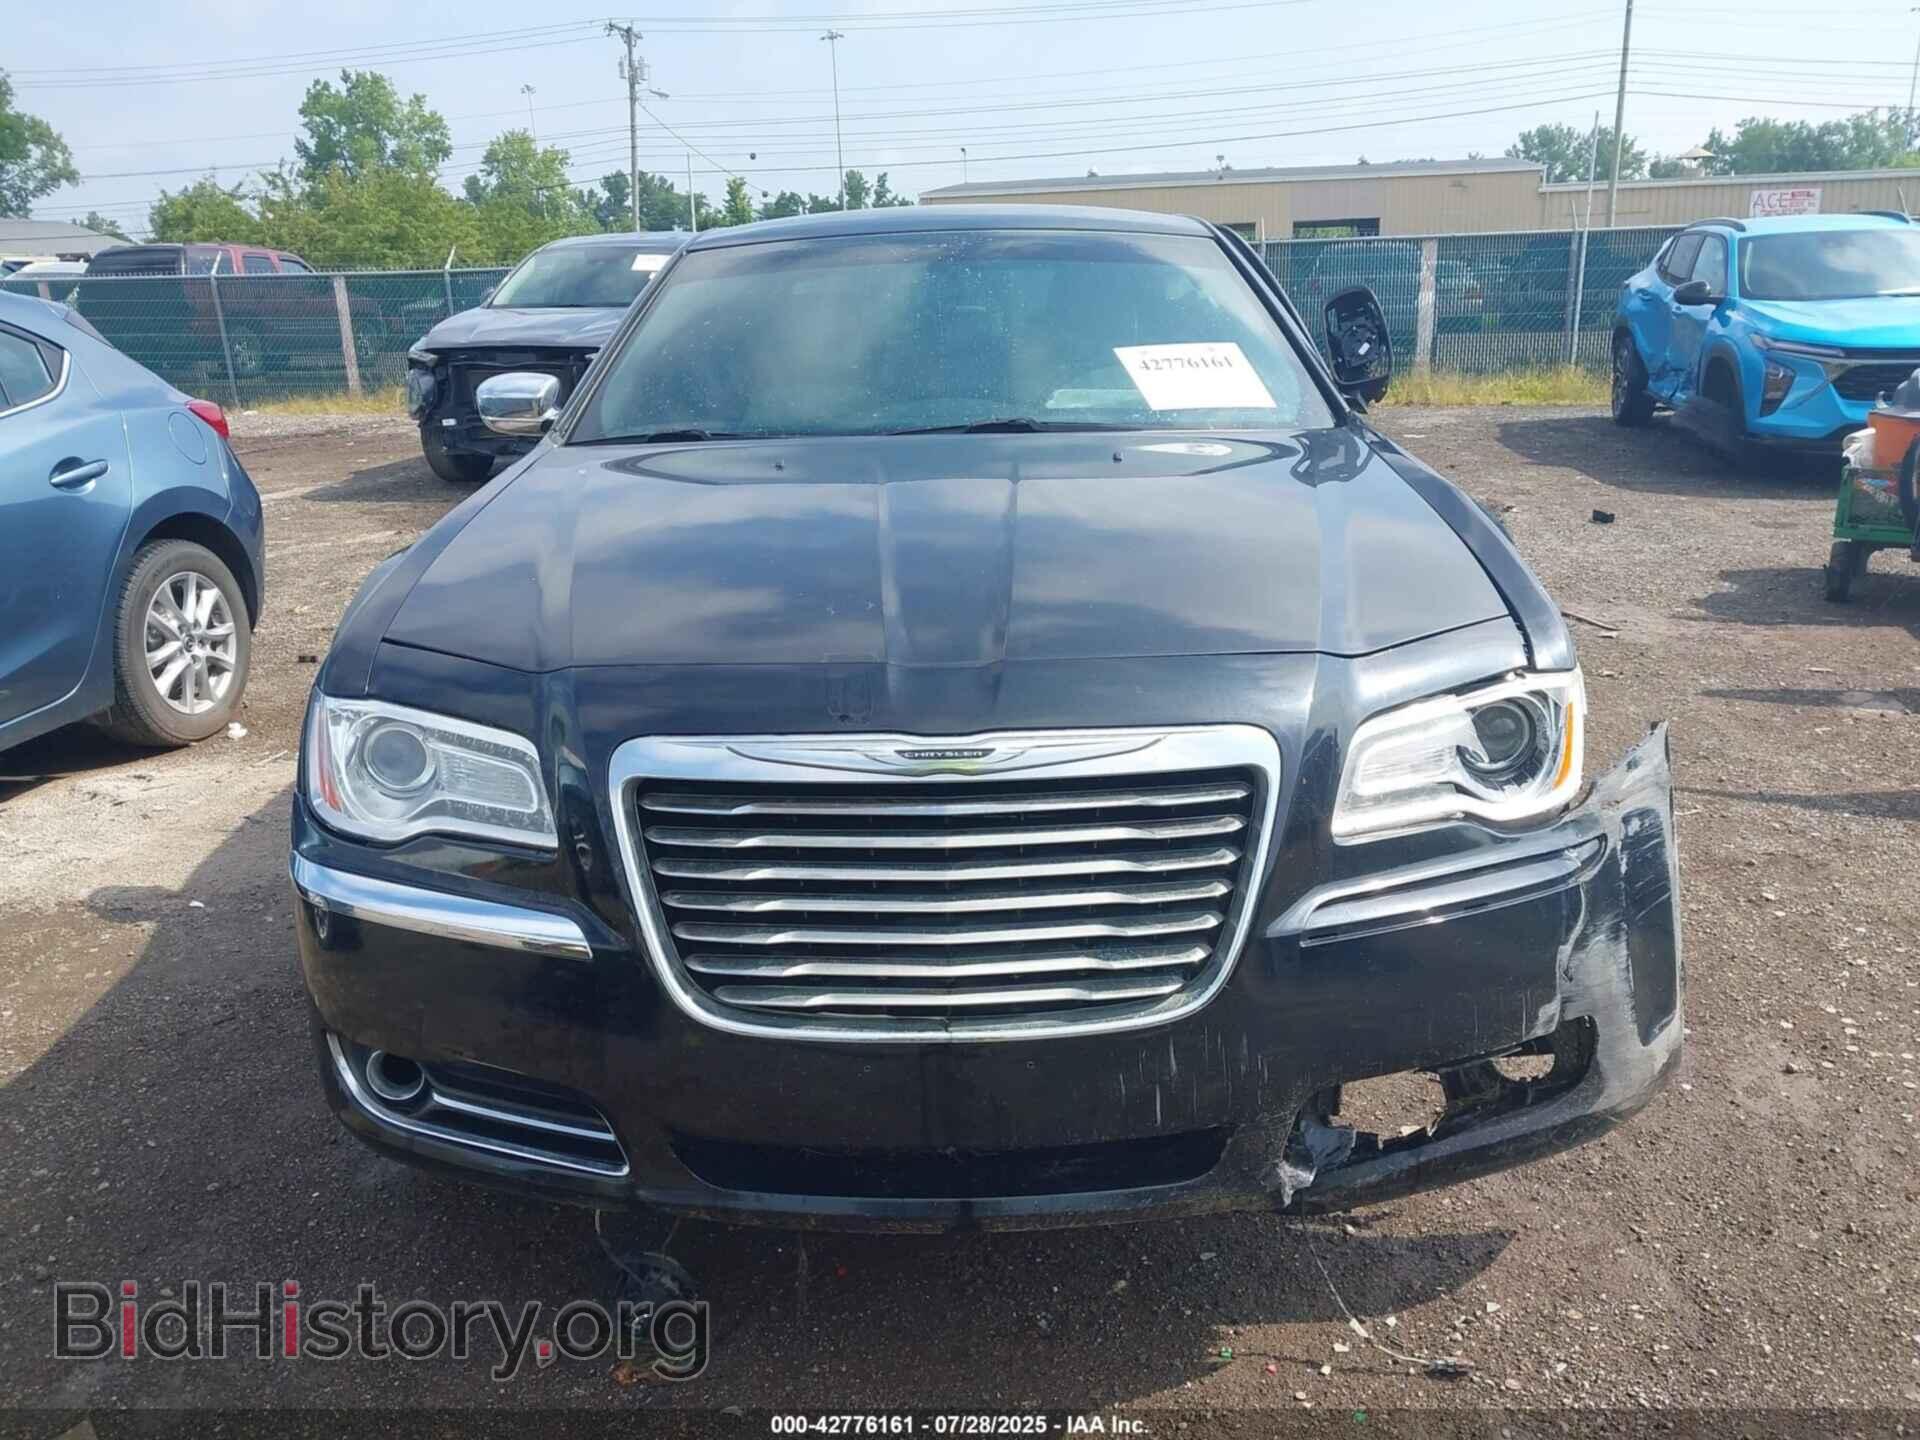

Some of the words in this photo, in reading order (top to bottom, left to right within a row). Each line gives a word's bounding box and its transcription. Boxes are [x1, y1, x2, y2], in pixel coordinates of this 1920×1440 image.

[1753, 192, 1789, 208] ACE
[1138, 355, 1233, 371] 42776161
[903, 751, 983, 759] CHRYSLER
